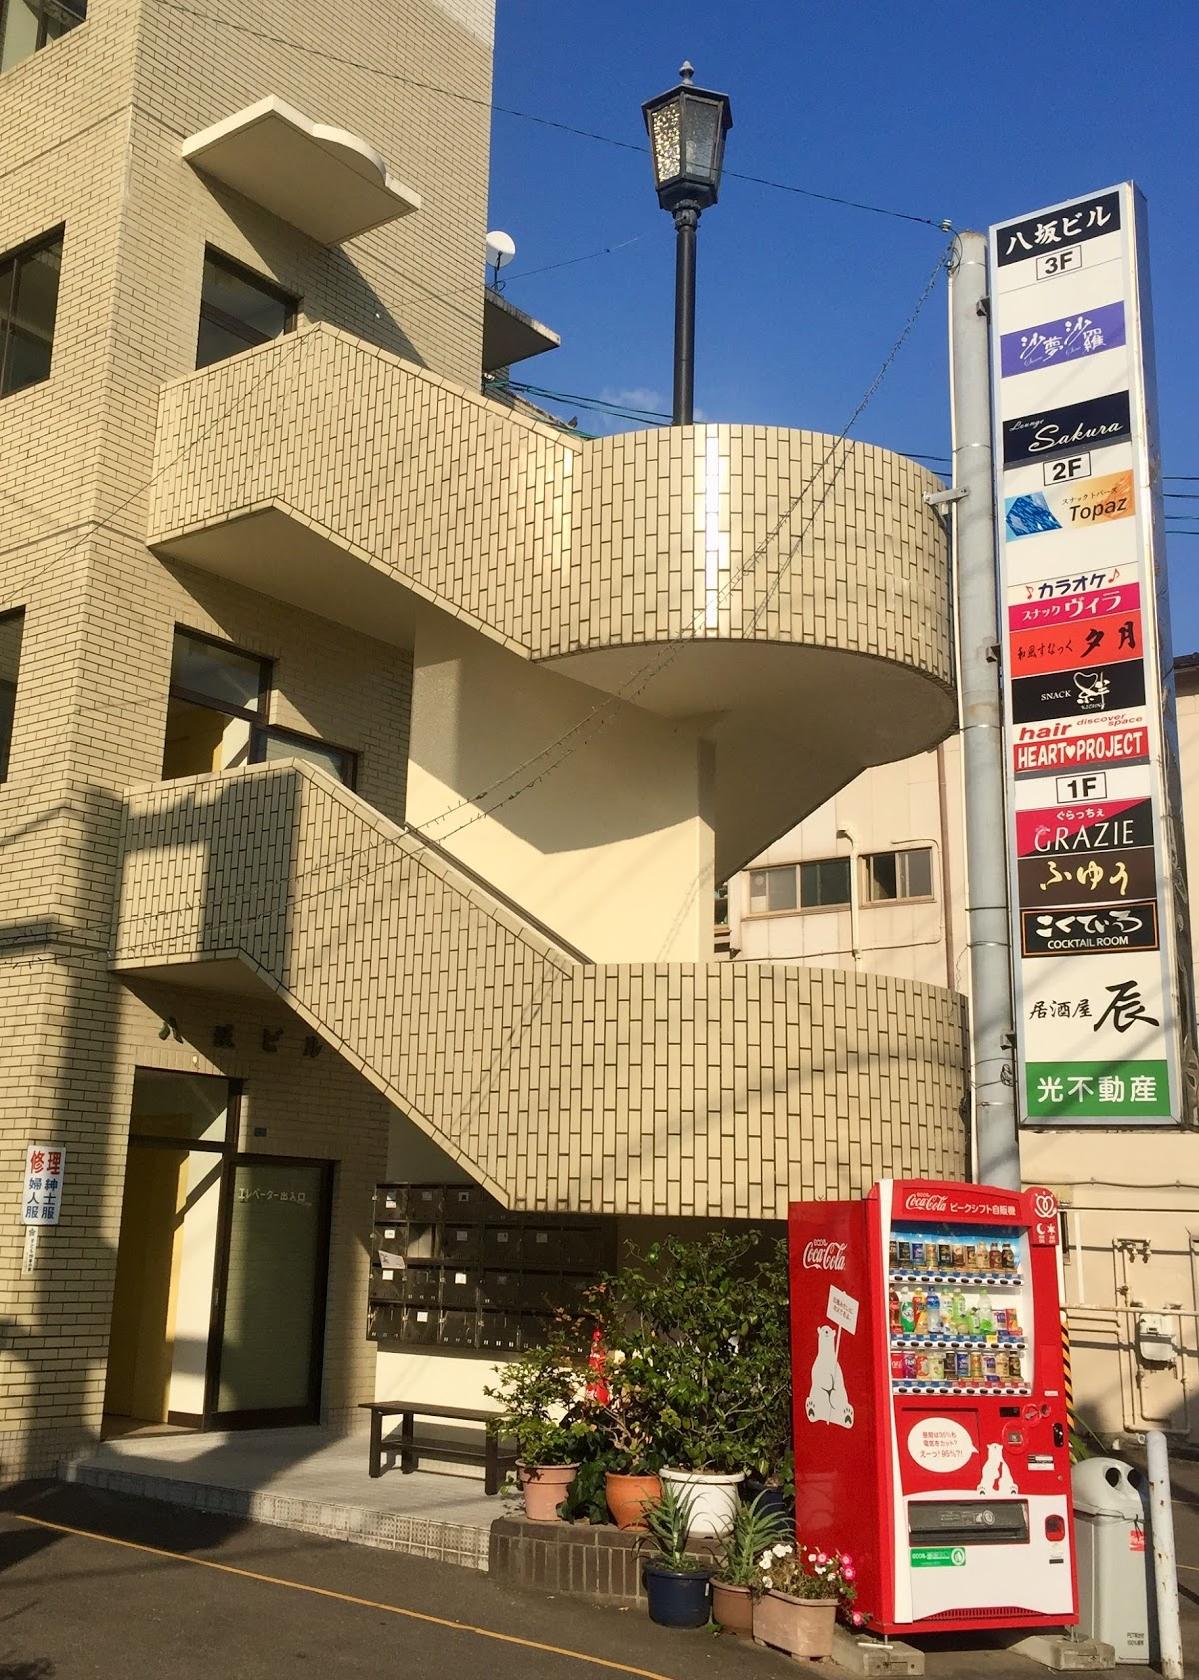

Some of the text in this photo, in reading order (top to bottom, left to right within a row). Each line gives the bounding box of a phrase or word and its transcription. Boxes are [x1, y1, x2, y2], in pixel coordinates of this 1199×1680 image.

[1006, 206, 1111, 255] 八坂ビル
[1045, 251, 1073, 275] 3F
[1028, 422, 1123, 452] Sakura
[1052, 457, 1082, 481] 2F
[1069, 497, 1127, 521] Topaz
[1038, 573, 1106, 599] カラオケ
[1022, 590, 1121, 621] スナック ヴィラ
[1080, 621, 1136, 658] 夕月
[1041, 690, 1072, 701] SNACK
[1019, 723, 1072, 741] hair
[1076, 714, 1127, 726] discover
[1108, 716, 1143, 727] space
[1018, 731, 1143, 768] HEART PROJECT
[1067, 777, 1097, 798] 1F
[1056, 808, 1105, 820] ぐらっちぇ
[1034, 820, 1134, 852] GRAZIE
[1039, 860, 1129, 896] ふゆう
[1047, 936, 1129, 949] COCKTAIL ROOM
[1029, 980, 1160, 1033] 居酒屋 辰
[1037, 1075, 1157, 1103] 光不動産
[30, 1151, 62, 1175] 修理
[25, 1178, 42, 1219] 婦人服
[41, 1178, 58, 1220] 紳士服
